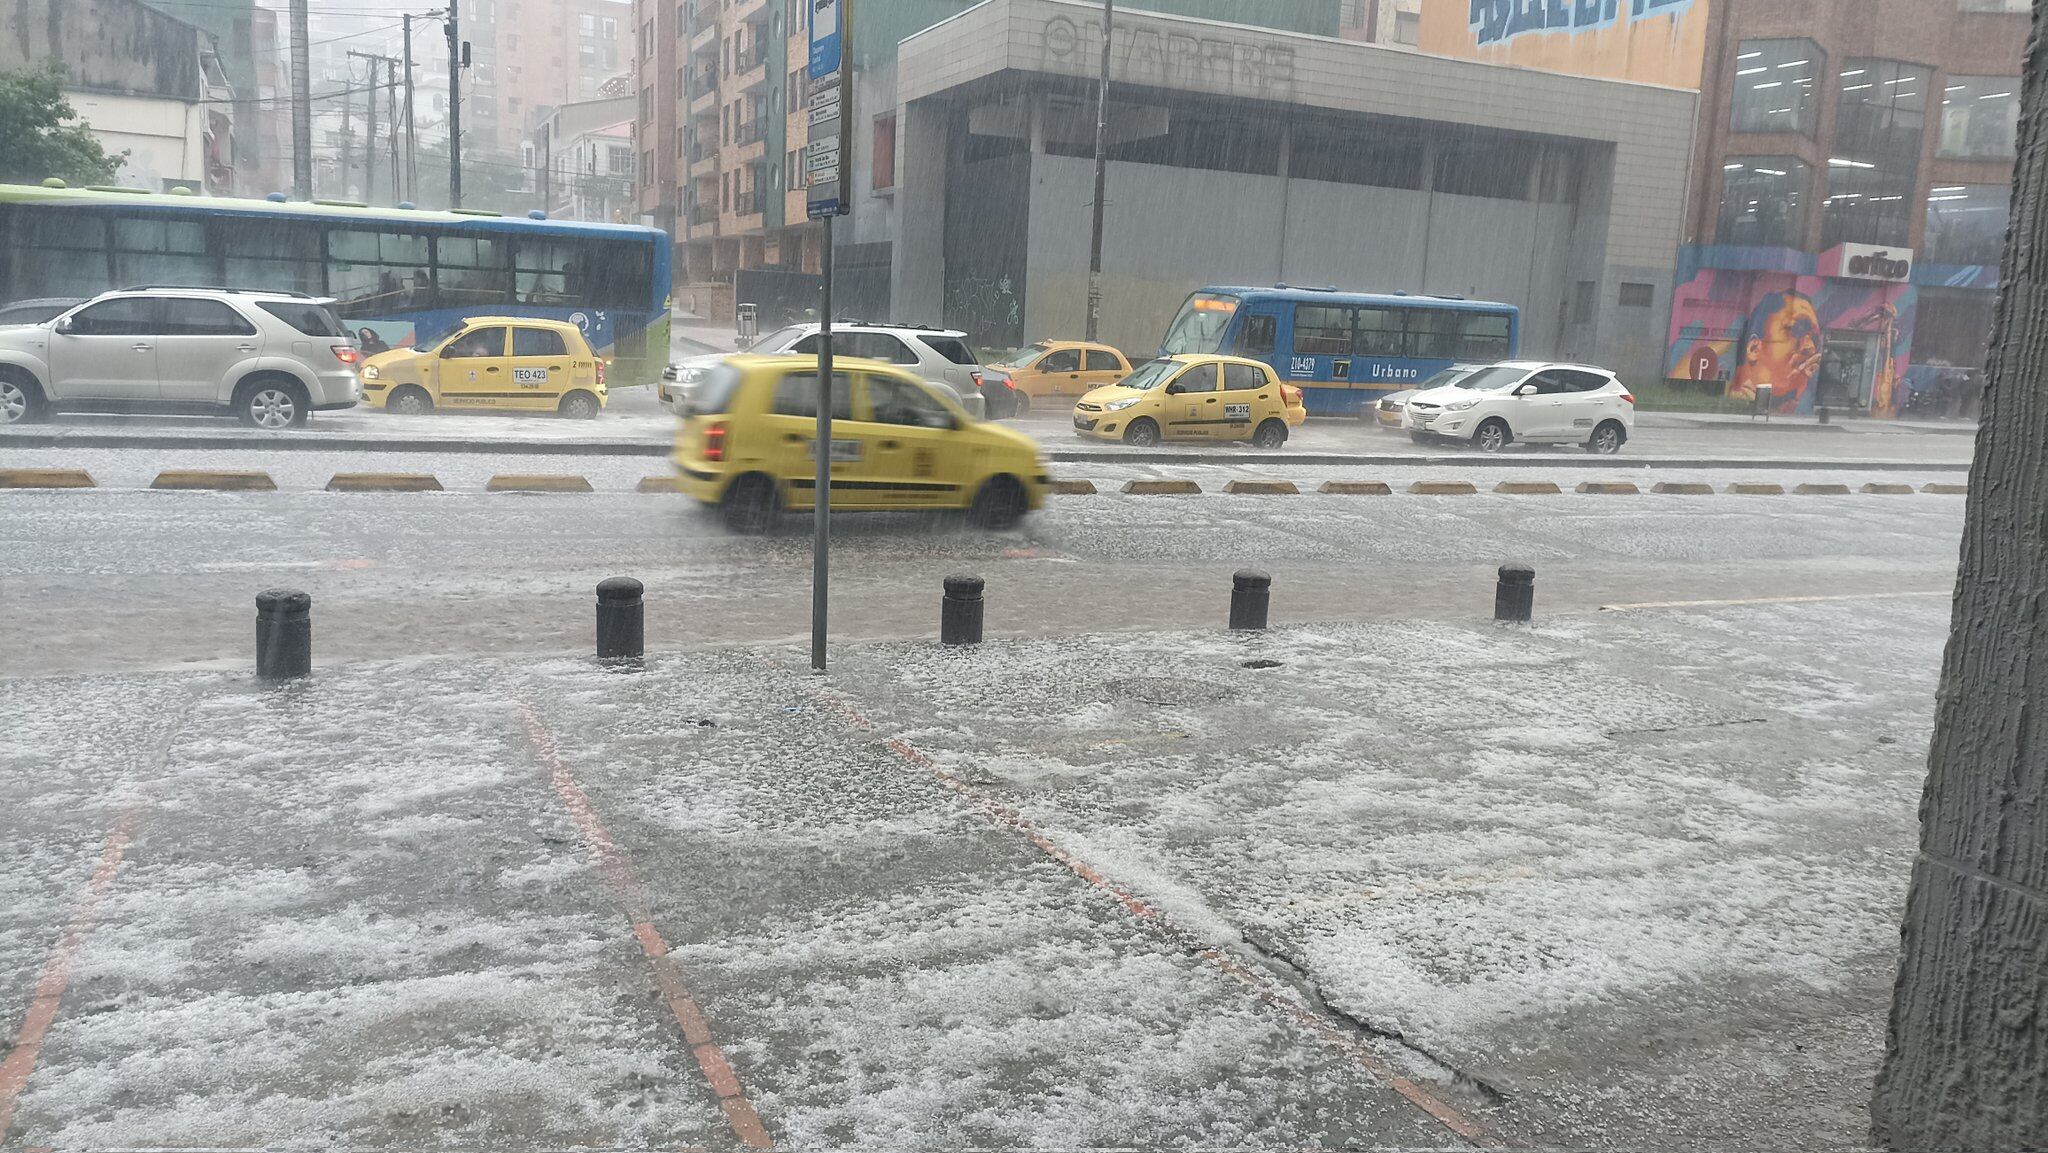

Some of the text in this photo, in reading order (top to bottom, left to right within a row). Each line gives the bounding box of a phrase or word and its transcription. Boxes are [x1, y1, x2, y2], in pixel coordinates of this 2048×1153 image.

[514, 370, 546, 380] TEO 423
[1372, 364, 1417, 378] Urbano
[1699, 358, 1709, 380] P
